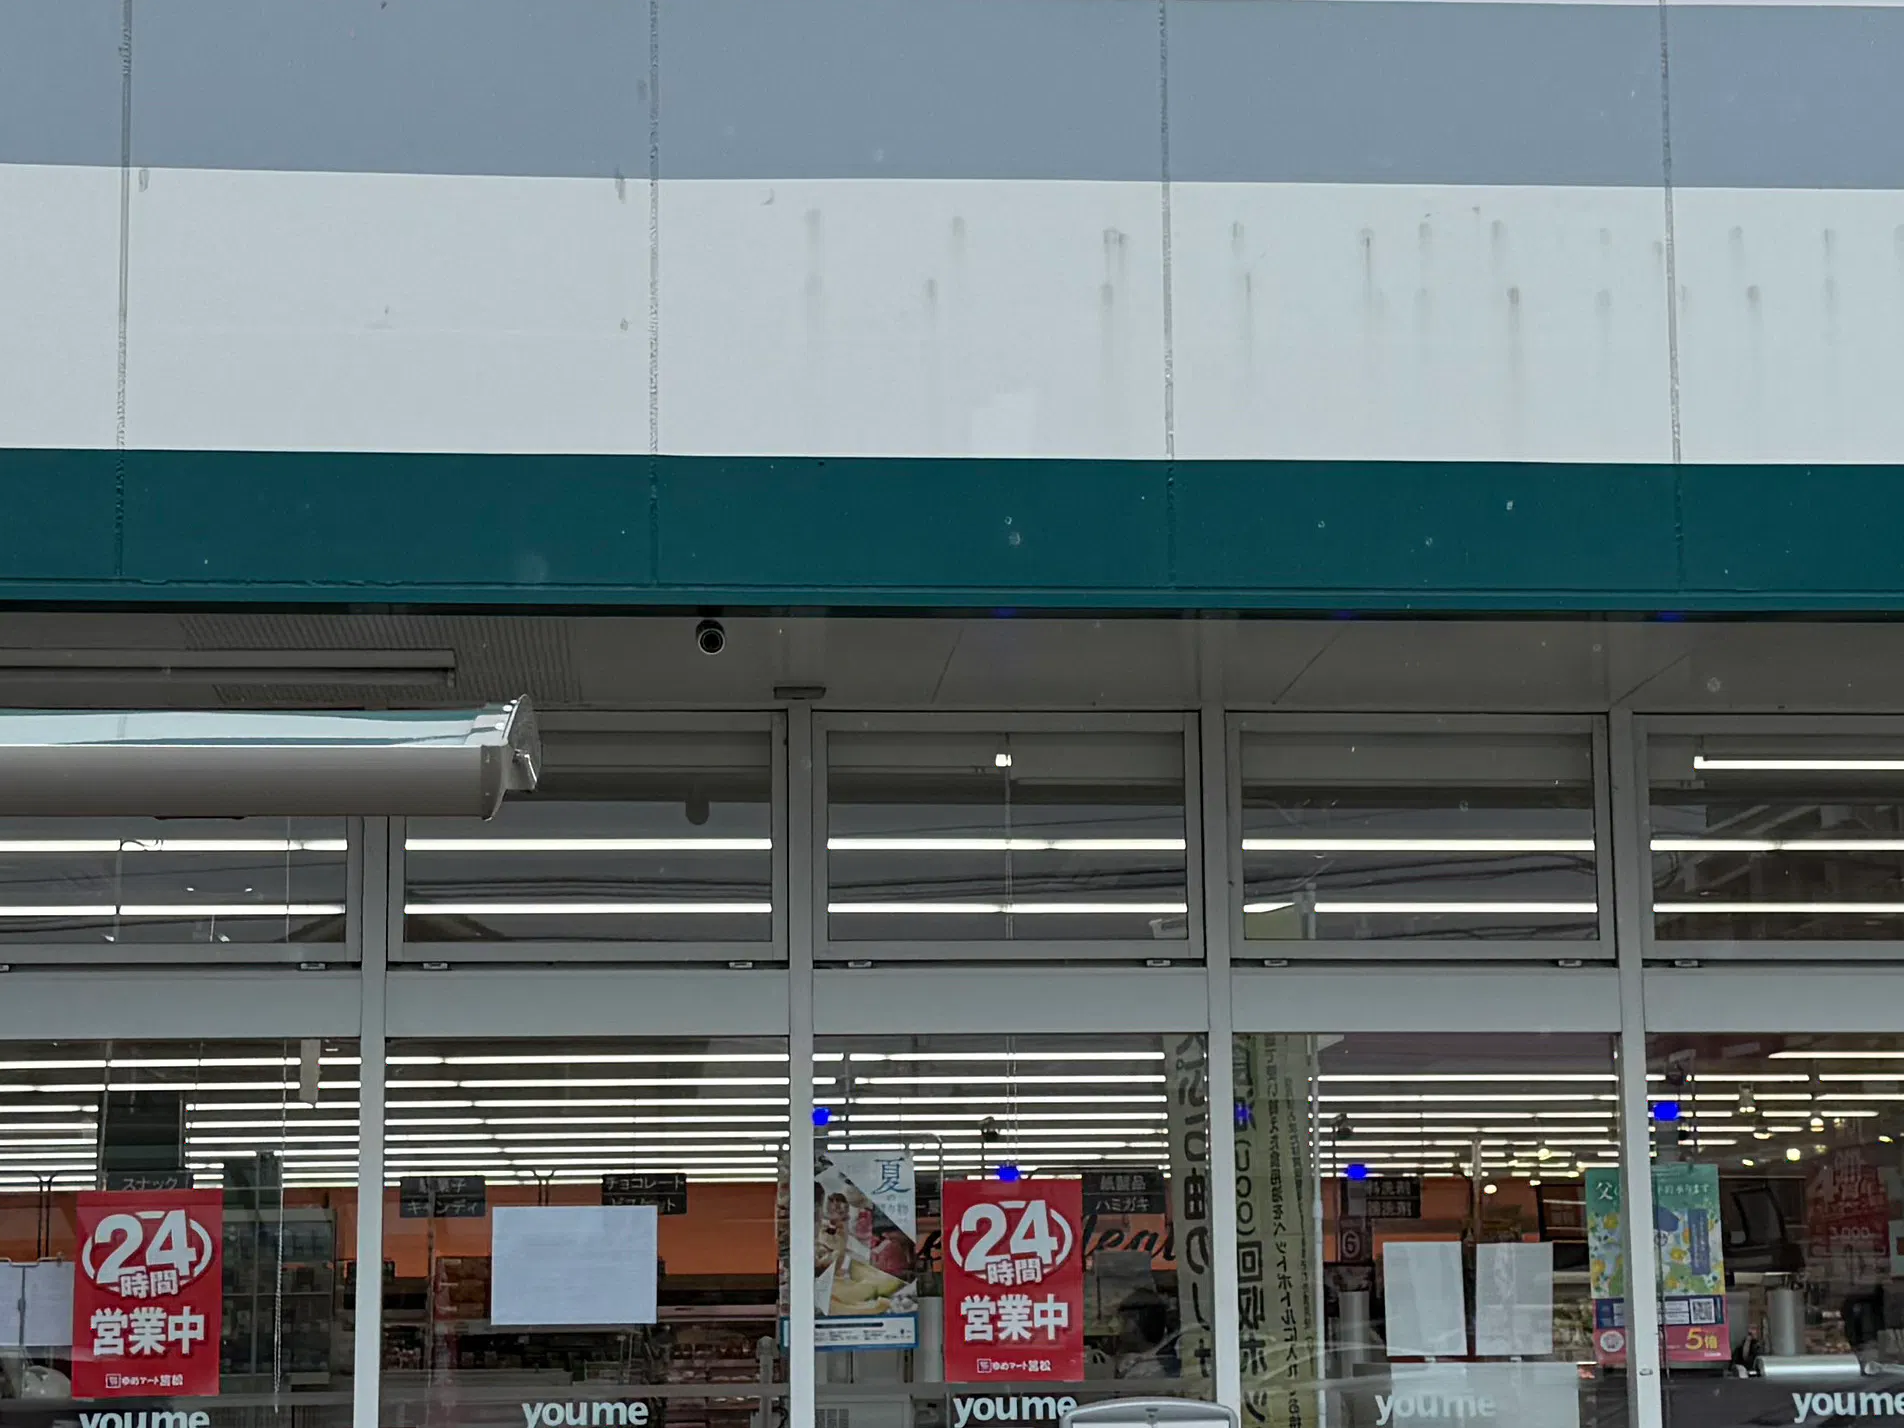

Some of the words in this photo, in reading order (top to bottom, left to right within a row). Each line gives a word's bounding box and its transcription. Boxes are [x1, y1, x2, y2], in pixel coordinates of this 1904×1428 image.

[872, 1157, 911, 1194] 夏
[1095, 1196, 1151, 1212] ハミガキ
[94, 1209, 197, 1285] 24
[961, 1199, 1059, 1272] 24
[120, 1269, 179, 1299] 時間
[987, 1258, 1043, 1286] 時間
[90, 1305, 205, 1356] 営業中
[961, 1293, 1069, 1342] 営業中
[952, 1395, 1078, 1428] youme
[1374, 1394, 1498, 1426] youme
